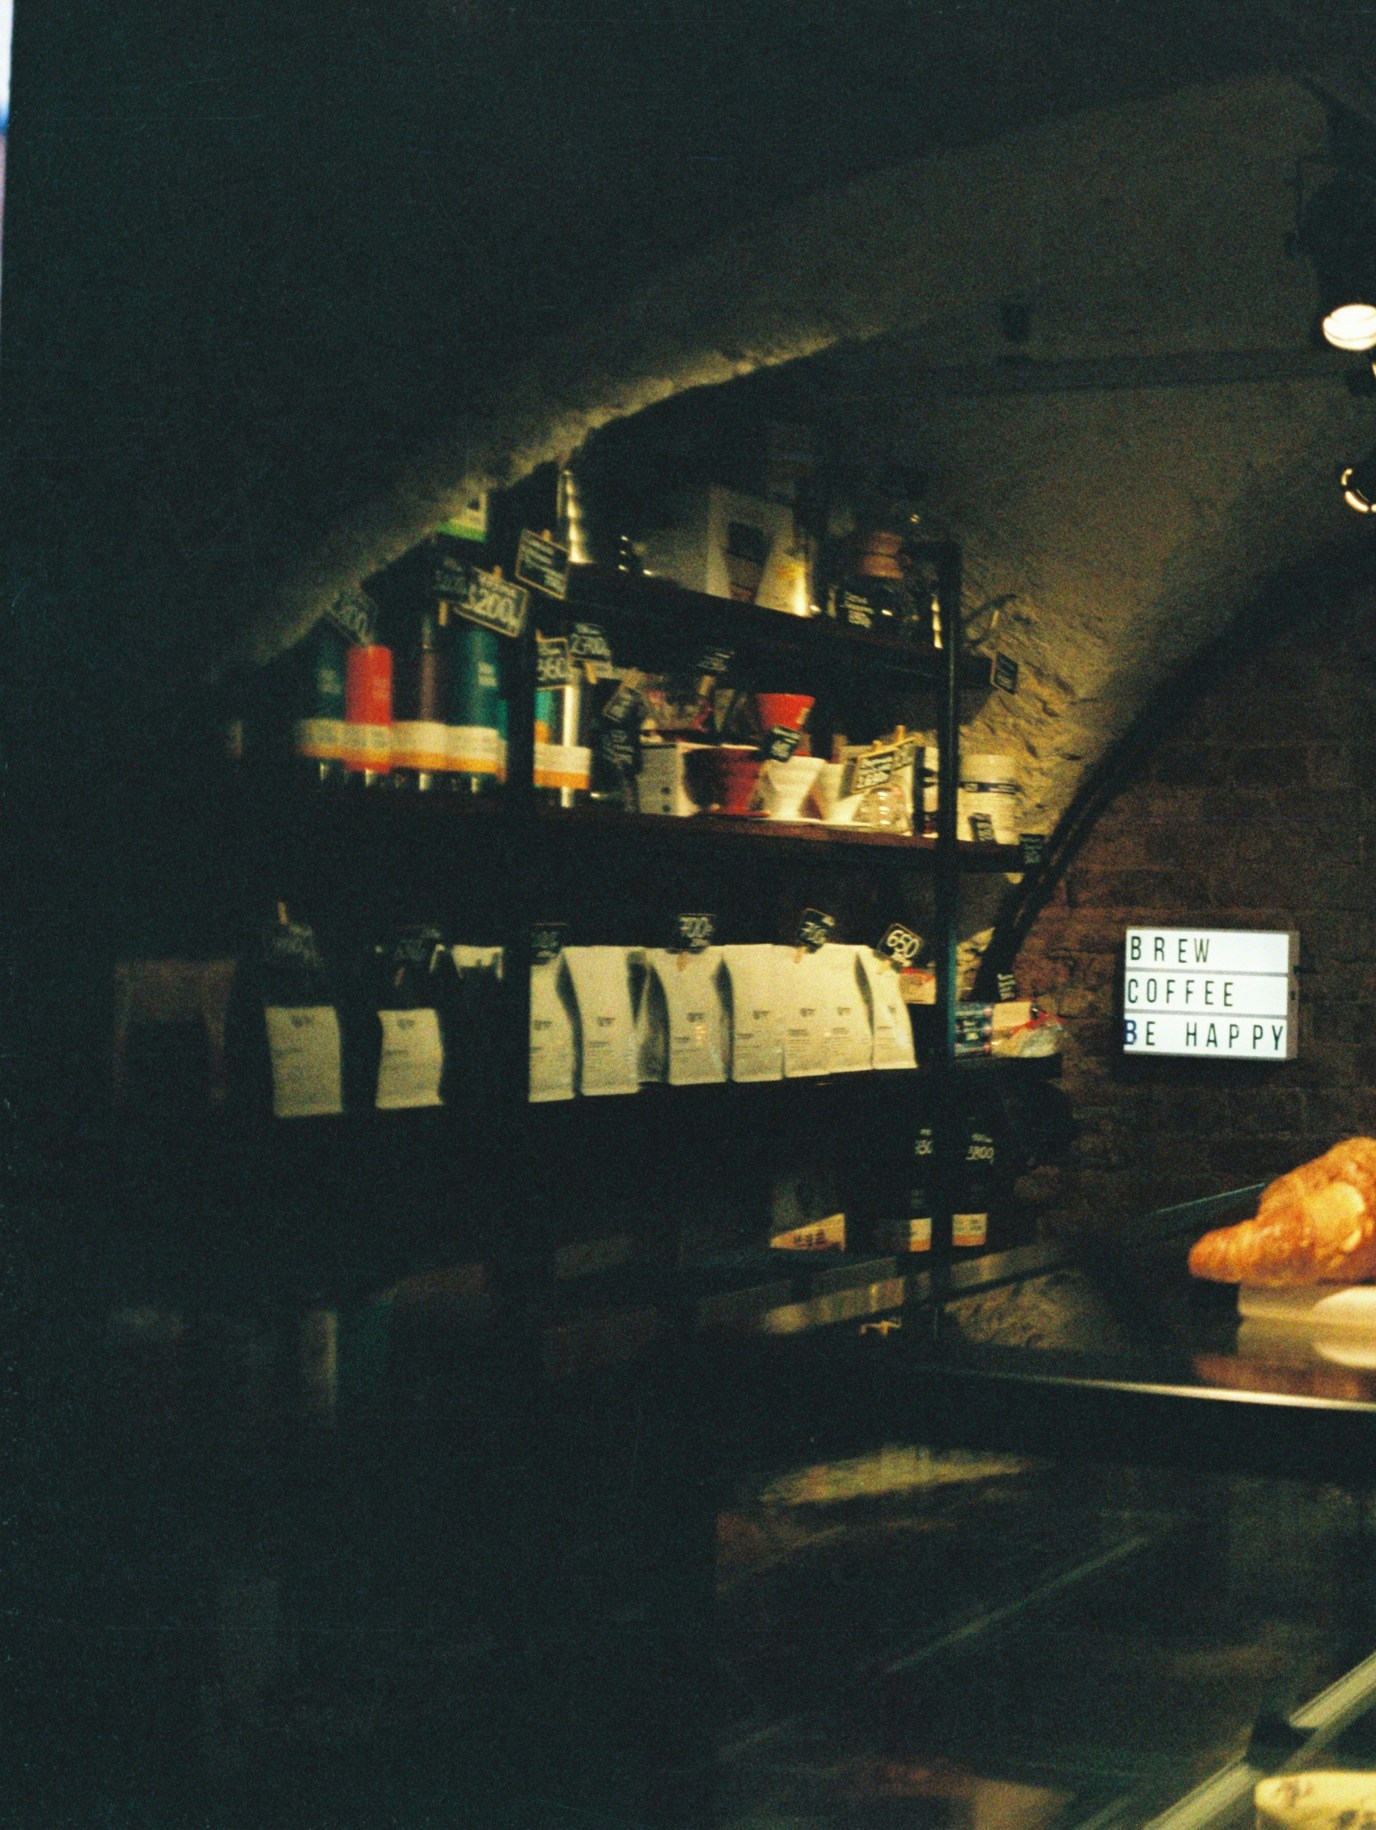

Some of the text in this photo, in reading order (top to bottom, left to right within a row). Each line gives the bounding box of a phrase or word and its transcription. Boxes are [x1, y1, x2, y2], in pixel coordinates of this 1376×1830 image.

[1130, 936, 1210, 963] BREW
[1127, 978, 1234, 1007] COFFEE
[1124, 1019, 1284, 1051] BE HAPPY
